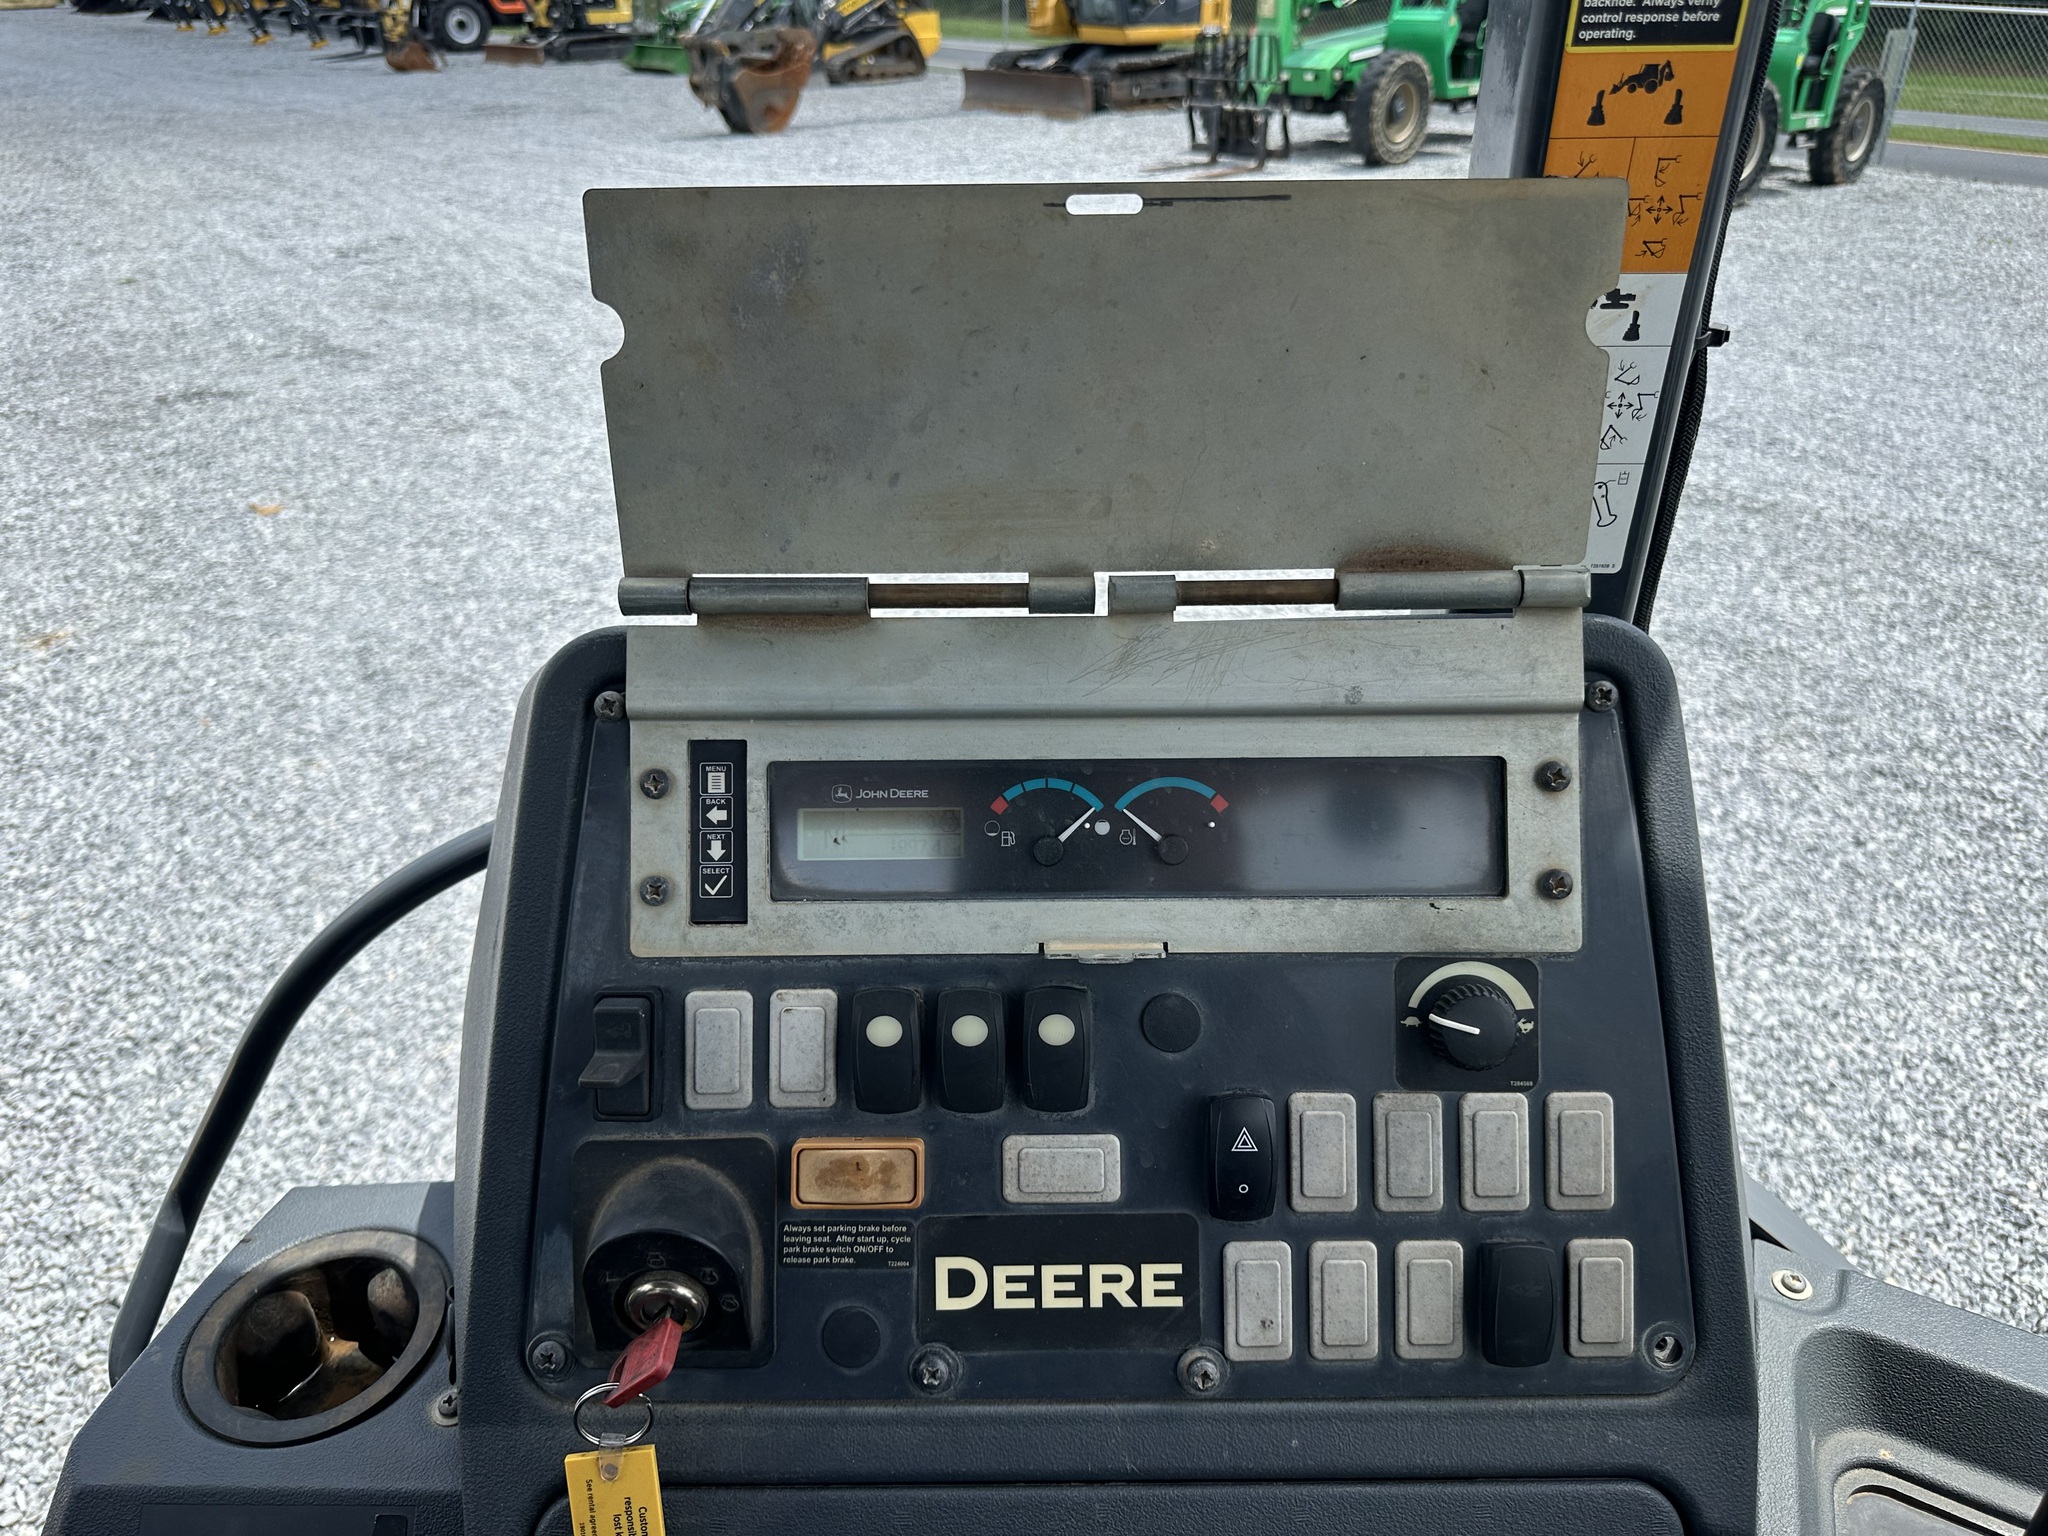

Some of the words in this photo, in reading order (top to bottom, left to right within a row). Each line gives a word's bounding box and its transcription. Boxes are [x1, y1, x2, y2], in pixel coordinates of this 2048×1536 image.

[1584, 0, 1636, 8] backhoe.
[1641, 0, 1685, 8] Always
[1581, 12, 1622, 23] control
[1624, 14, 1679, 25] response
[1682, 11, 1720, 22] before
[1578, 27, 1636, 41] operating.
[855, 788, 888, 799] JOHN
[890, 789, 929, 798] DEERE
[783, 1224, 812, 1234] Always
[827, 1224, 856, 1234] parking
[783, 1235, 812, 1244] leaving
[890, 1235, 912, 1244] cycle
[783, 1246, 800, 1254] park
[813, 1256, 830, 1264] park
[935, 1256, 1183, 1310] DEERE
[588, 1493, 596, 1513] rental
[613, 1514, 622, 1530] lost
